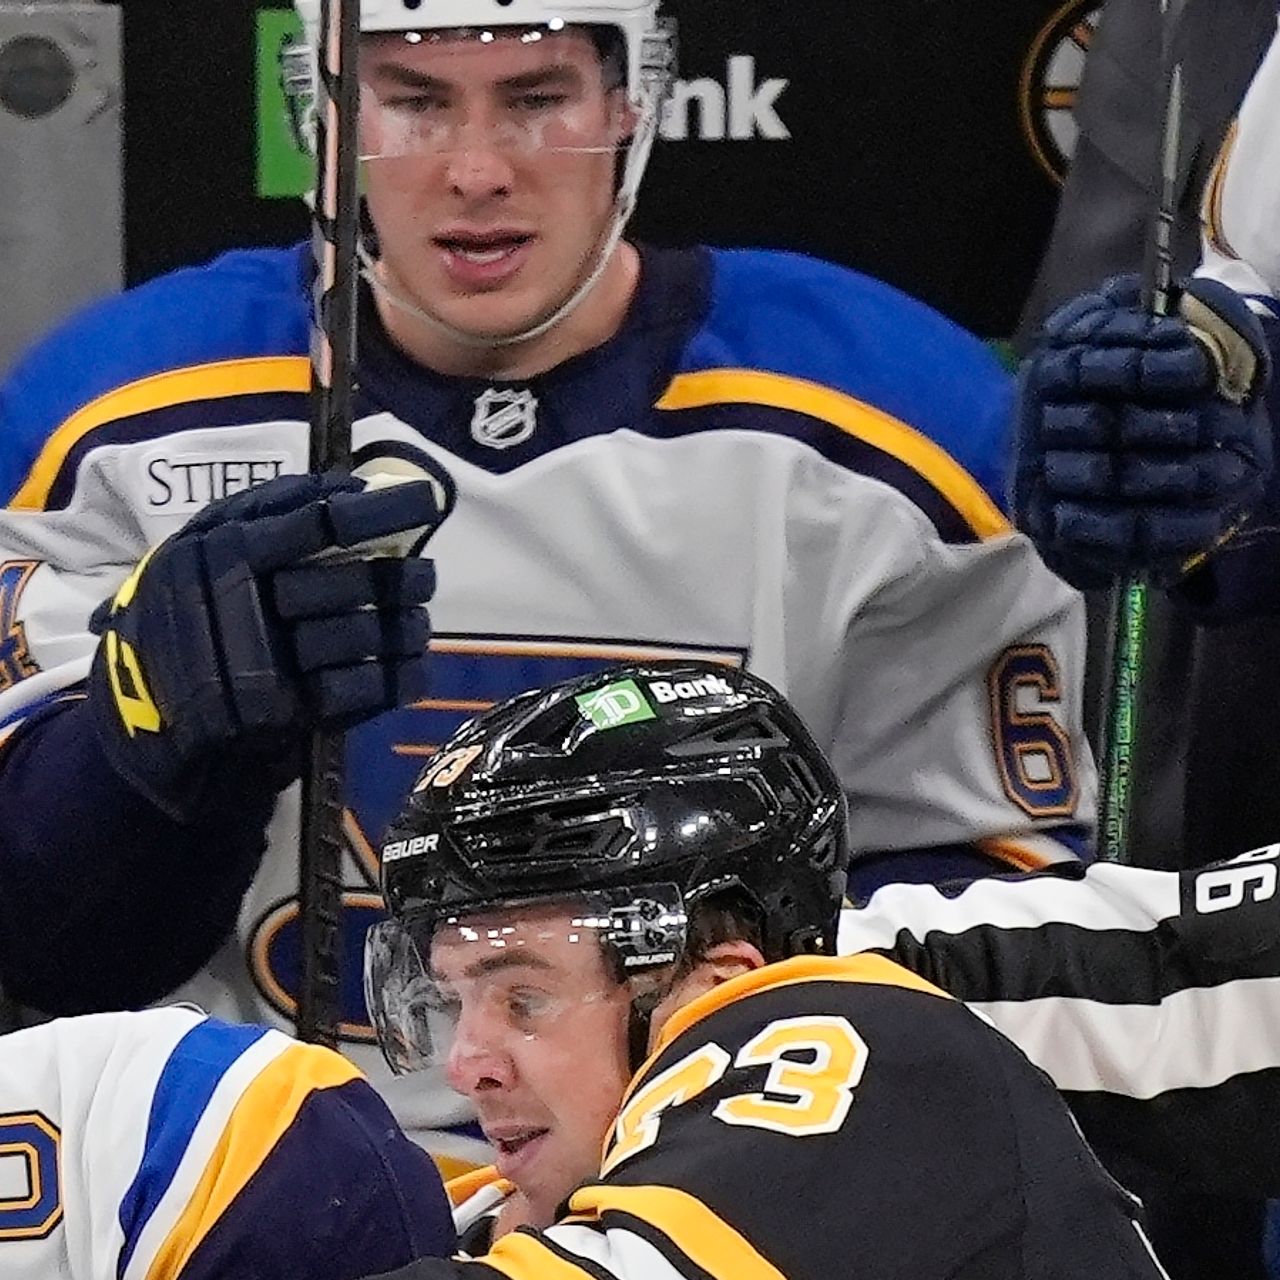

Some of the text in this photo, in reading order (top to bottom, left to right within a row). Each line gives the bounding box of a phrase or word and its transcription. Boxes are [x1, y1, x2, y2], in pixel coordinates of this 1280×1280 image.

[658, 55, 791, 142] nk
[648, 673, 733, 703] Bank
[988, 643, 1082, 819] 6
